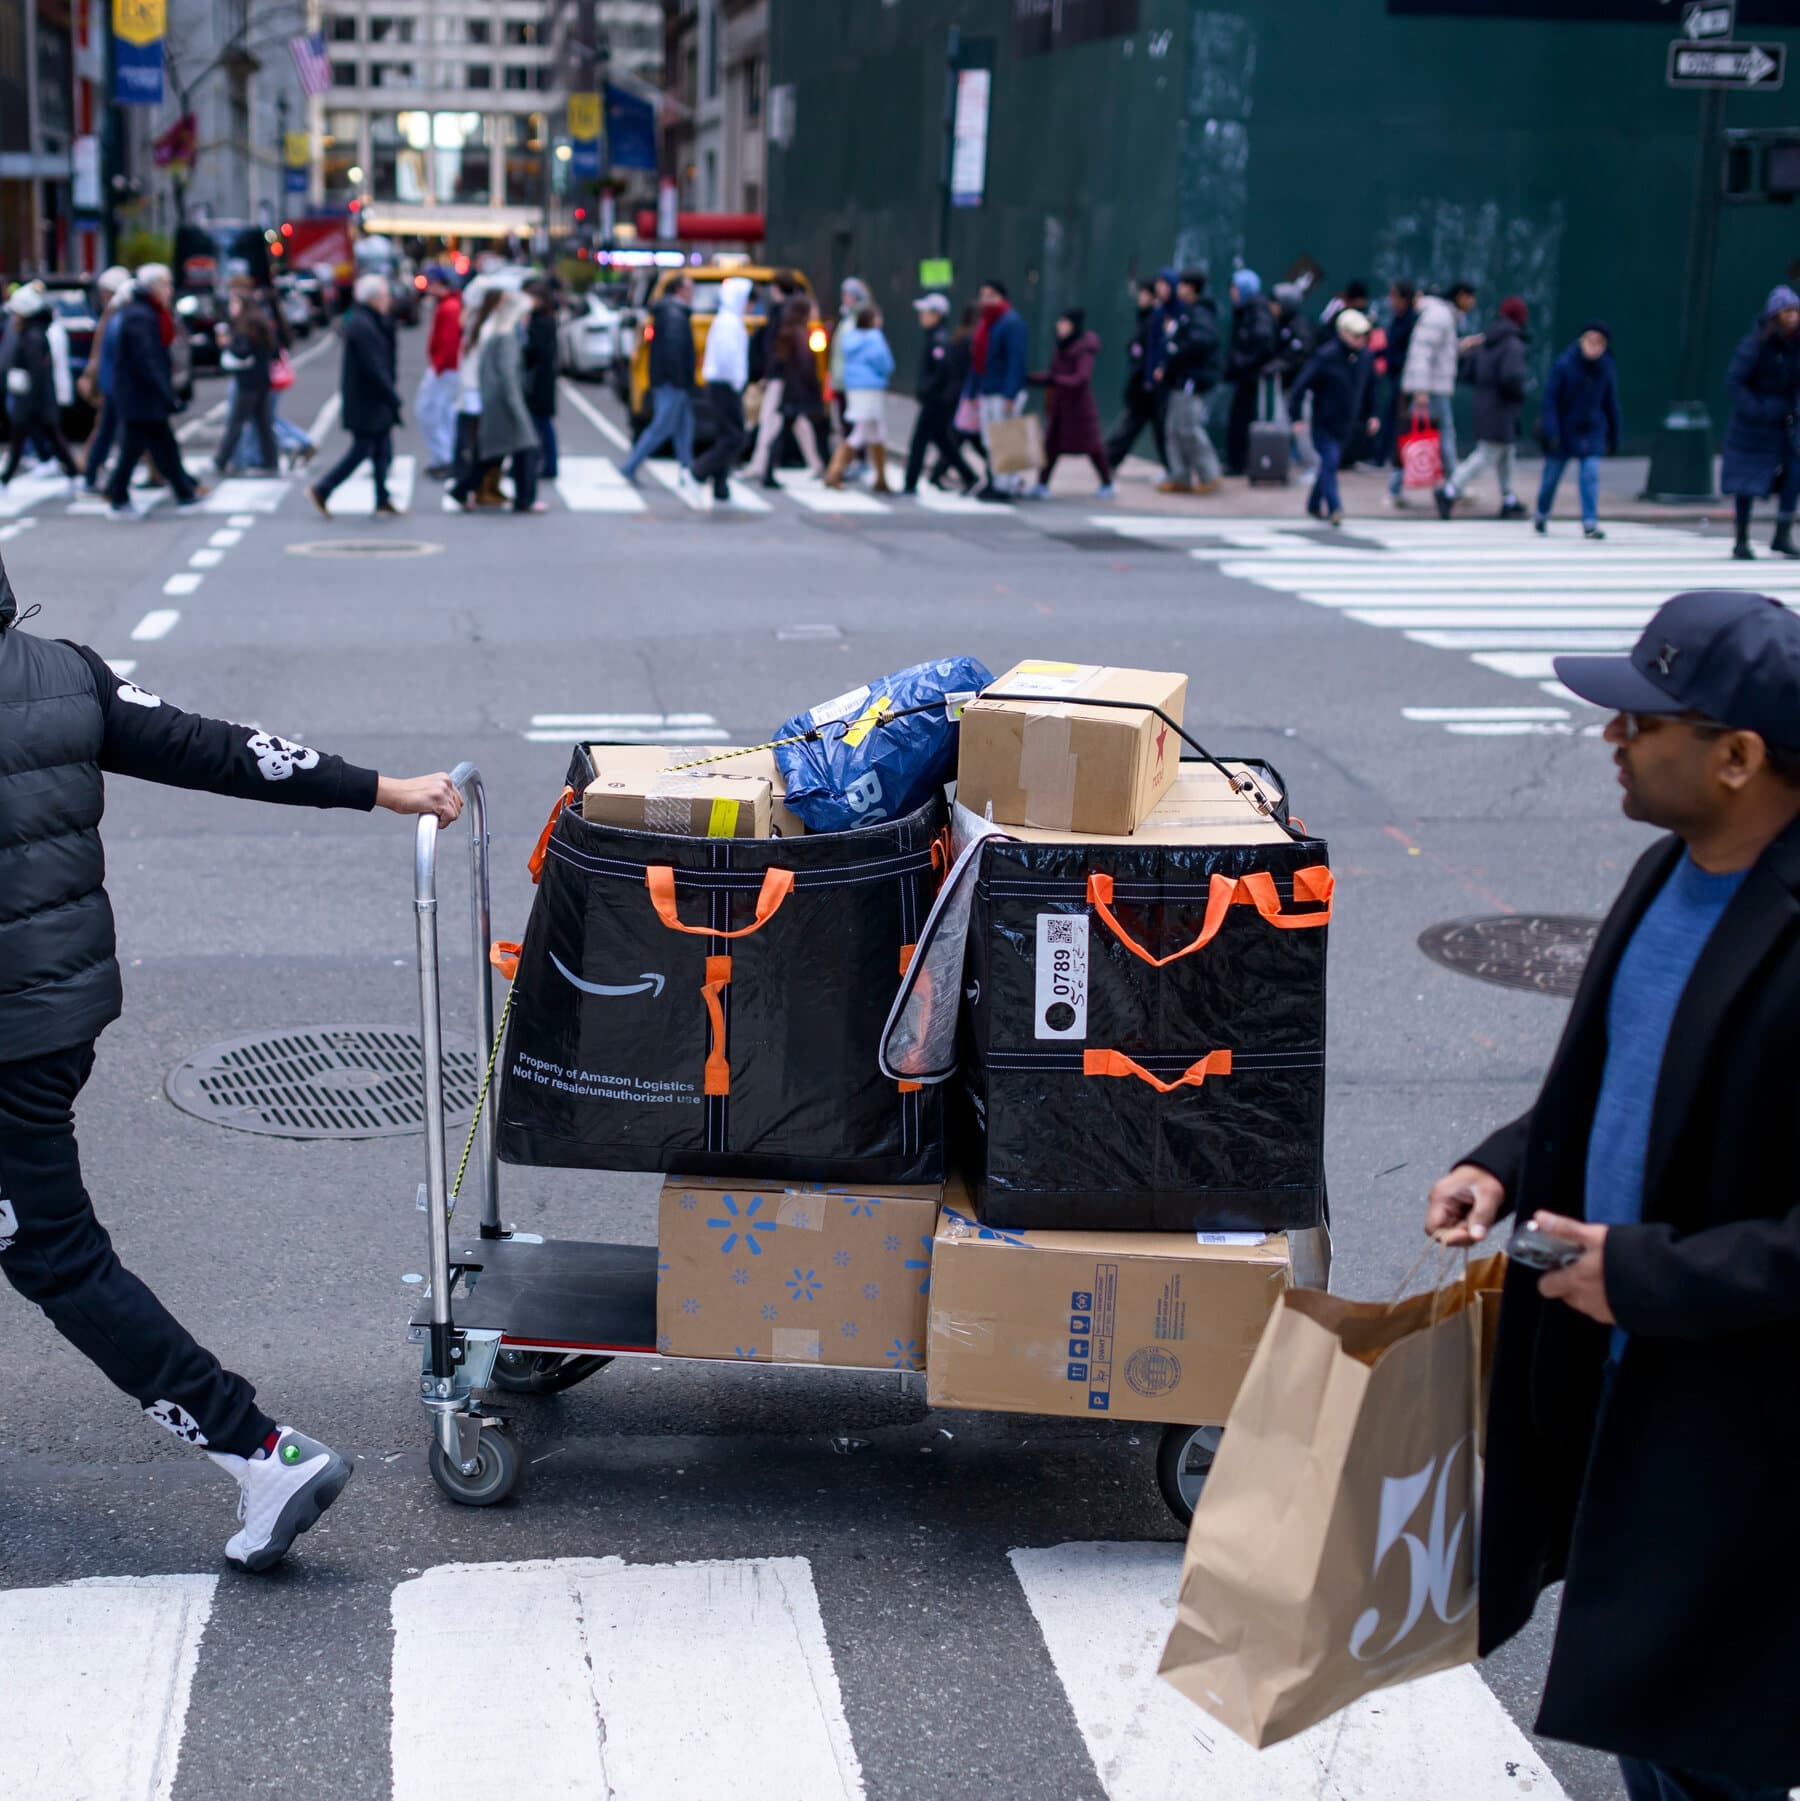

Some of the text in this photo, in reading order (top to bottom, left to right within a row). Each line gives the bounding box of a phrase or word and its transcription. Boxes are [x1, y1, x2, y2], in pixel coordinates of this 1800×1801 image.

[1053, 949, 1070, 995] 0789
[513, 1064, 701, 1104] Not for resale/unauthorized use
[519, 1051, 695, 1092] Property of Amazon Logistics
